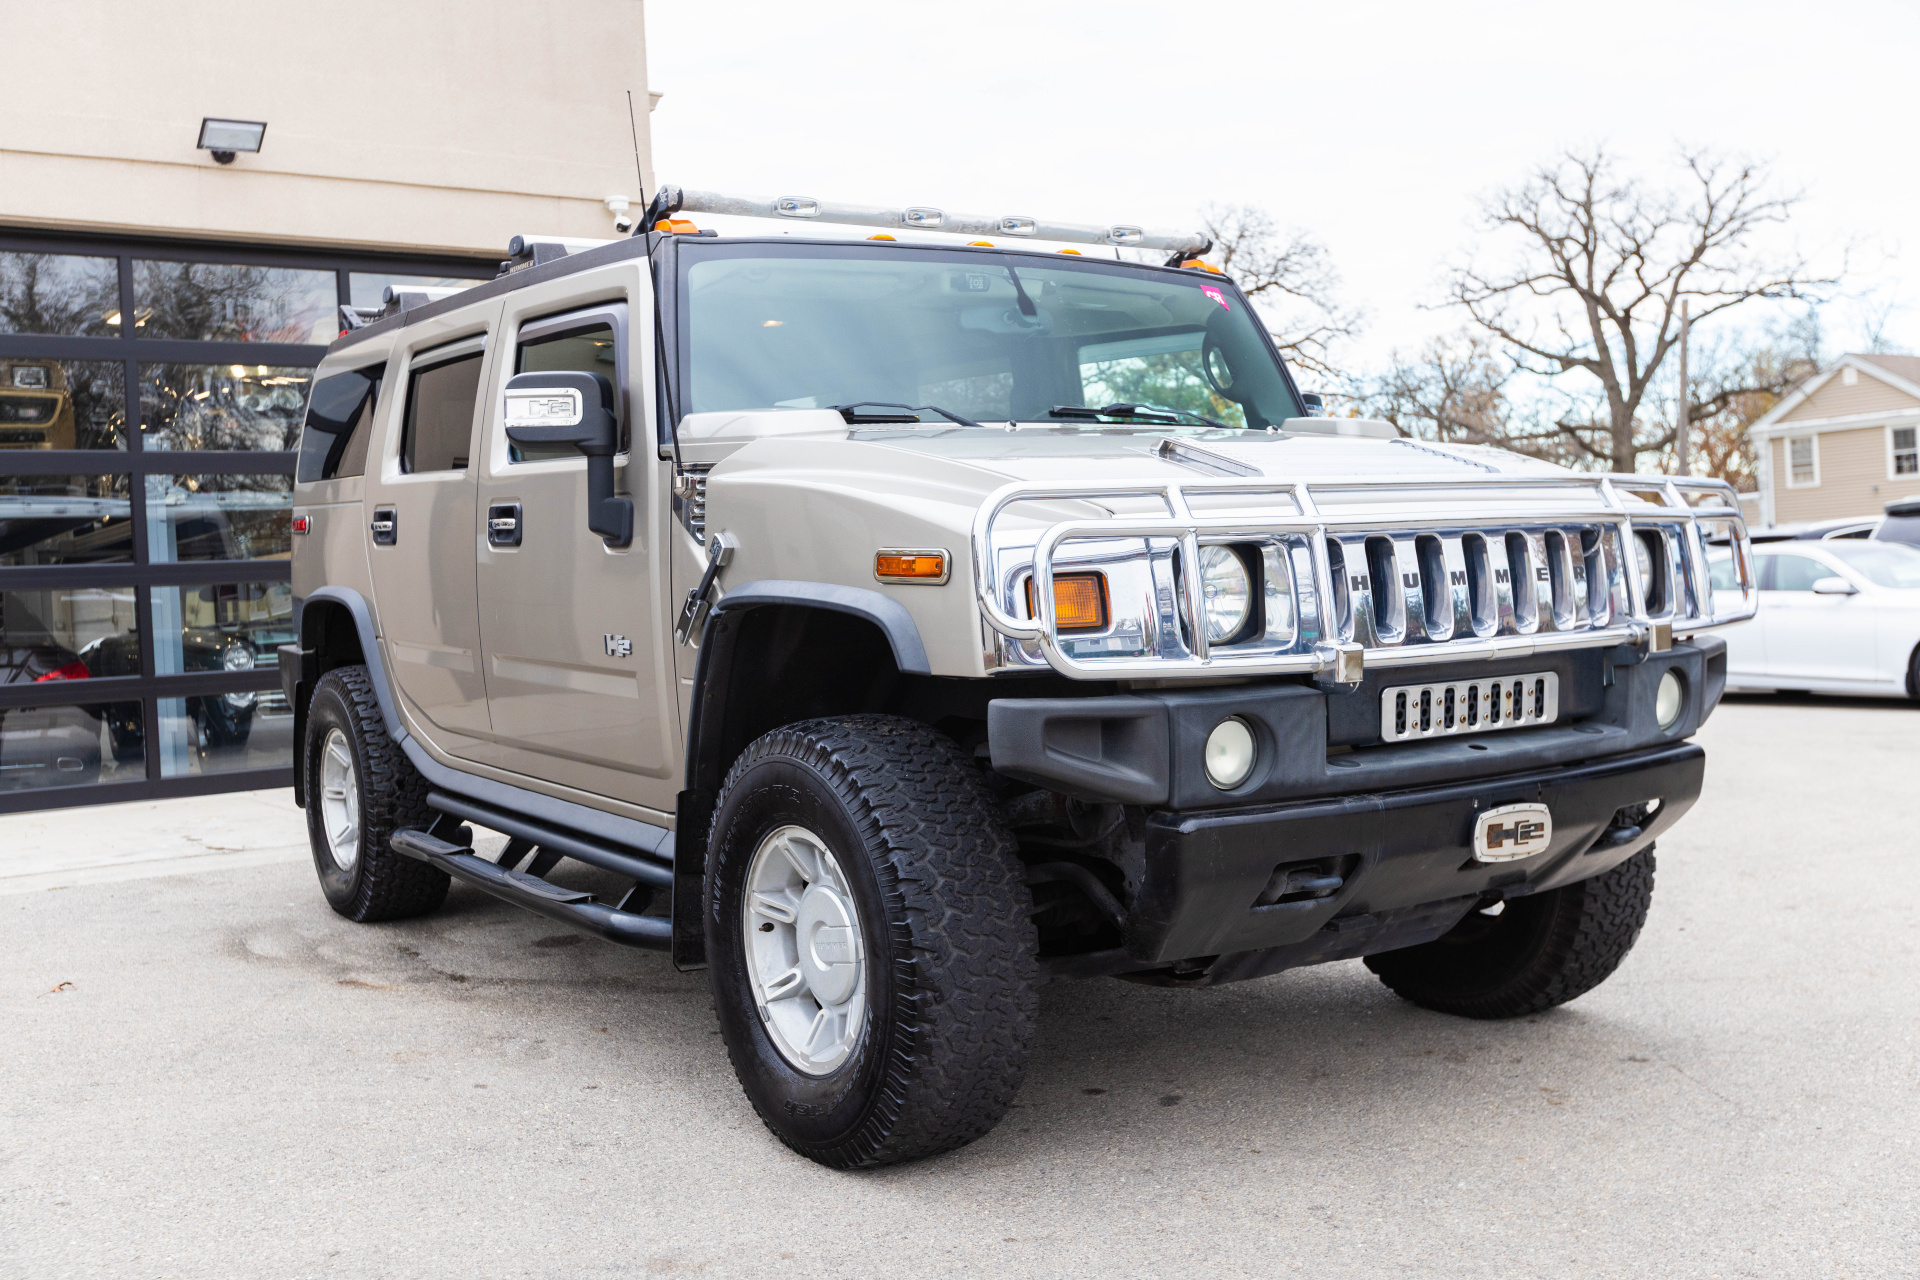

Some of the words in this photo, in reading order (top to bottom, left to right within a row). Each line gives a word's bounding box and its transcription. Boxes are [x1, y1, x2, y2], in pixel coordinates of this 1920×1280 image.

[529, 399, 571, 416] H2
[604, 633, 633, 657] H2
[1486, 820, 1545, 850] H2
